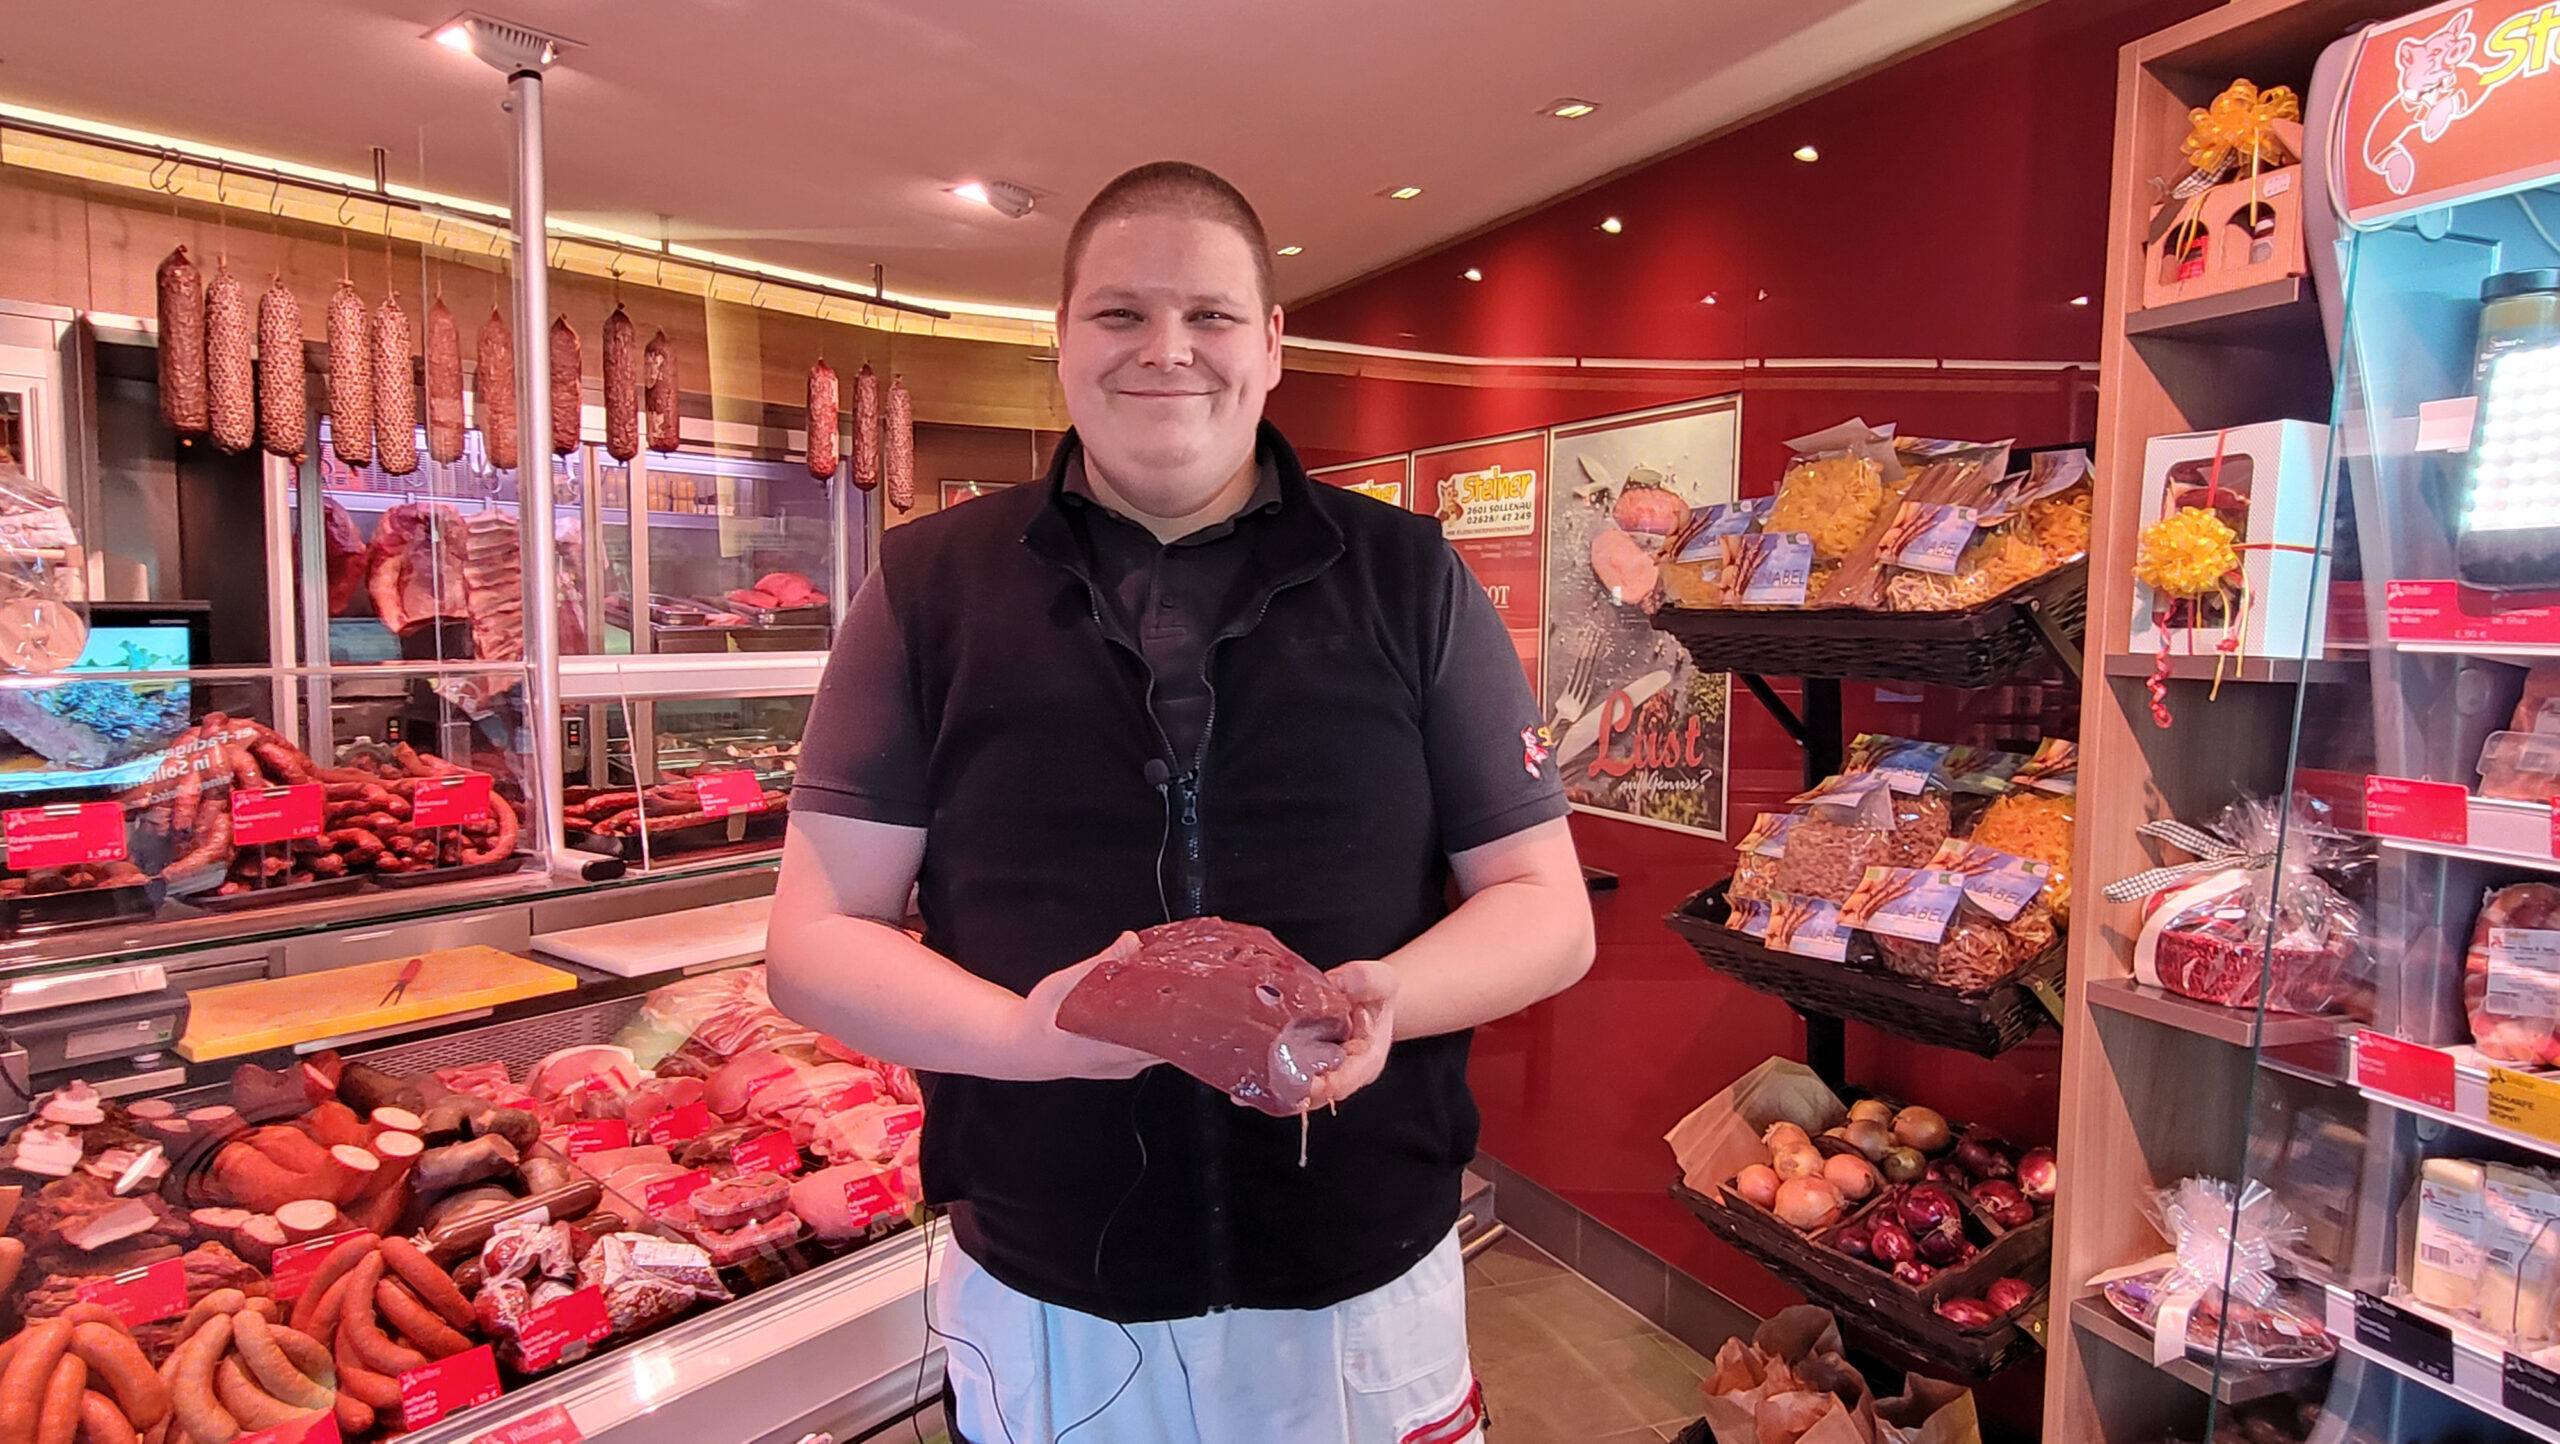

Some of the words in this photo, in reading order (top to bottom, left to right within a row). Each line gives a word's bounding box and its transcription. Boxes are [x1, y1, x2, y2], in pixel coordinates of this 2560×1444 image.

[2478, 5, 2560, 86] St
[1462, 468, 1532, 503] Steiner
[1489, 501, 1532, 514] SOLLENAU
[1501, 514, 1512, 523] 47
[1514, 512, 1532, 521] 249
[1484, 585, 1511, 606] OT
[1588, 690, 1704, 779] Lust
[1649, 769, 1713, 798] Genuss?
